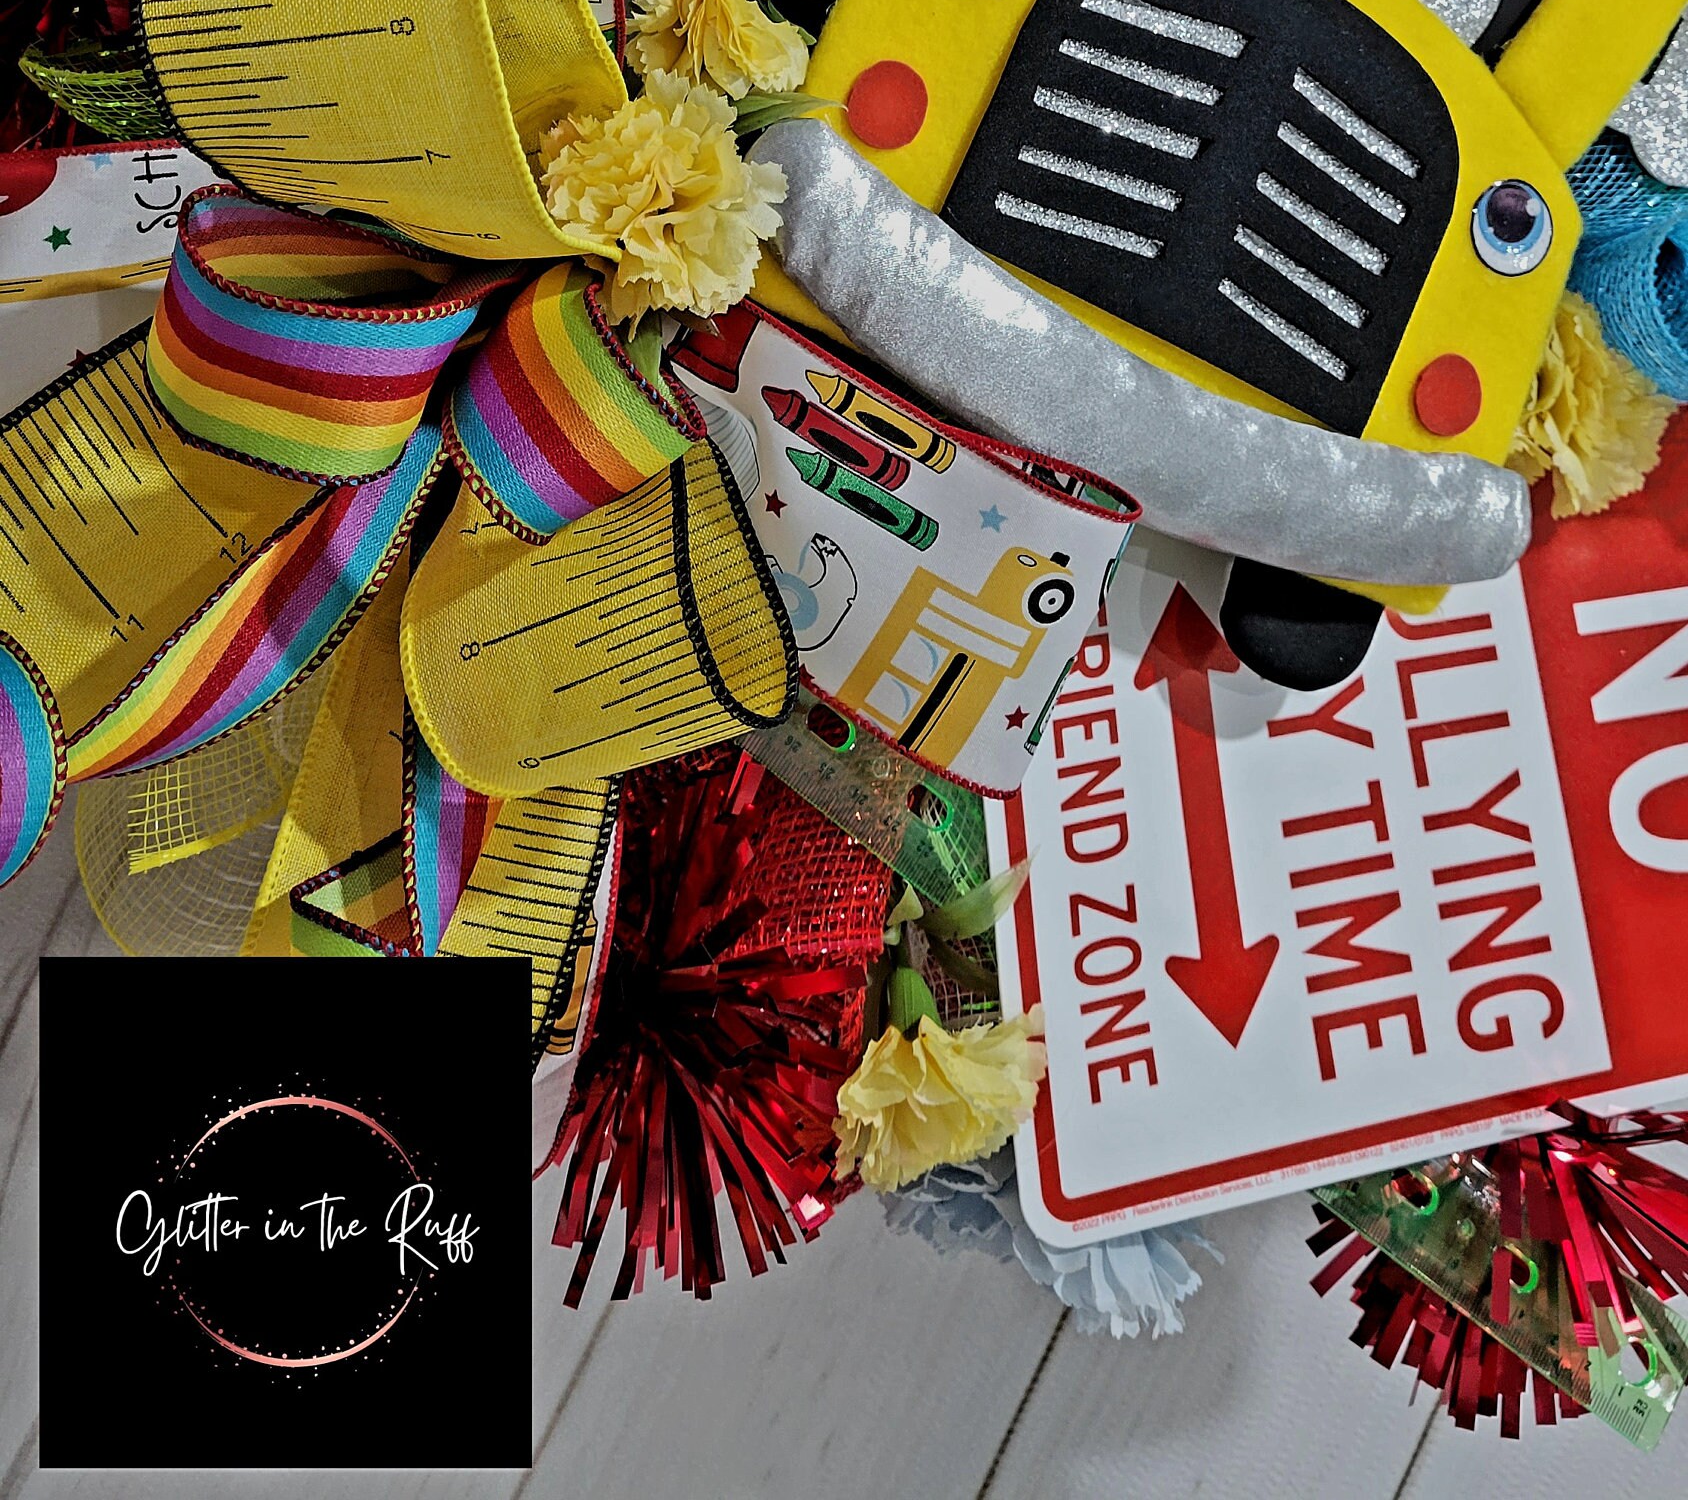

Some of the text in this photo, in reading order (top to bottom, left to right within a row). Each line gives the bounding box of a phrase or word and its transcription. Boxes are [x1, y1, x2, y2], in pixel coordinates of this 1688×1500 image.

[389, 17, 415, 36] 8
[424, 149, 451, 165] 7
[219, 532, 254, 563] 12
[110, 614, 145, 642] 11
[460, 641, 480, 660] 8
[1052, 600, 1158, 1105] RIEND ZONE
[1280, 779, 1427, 1082] TIME
